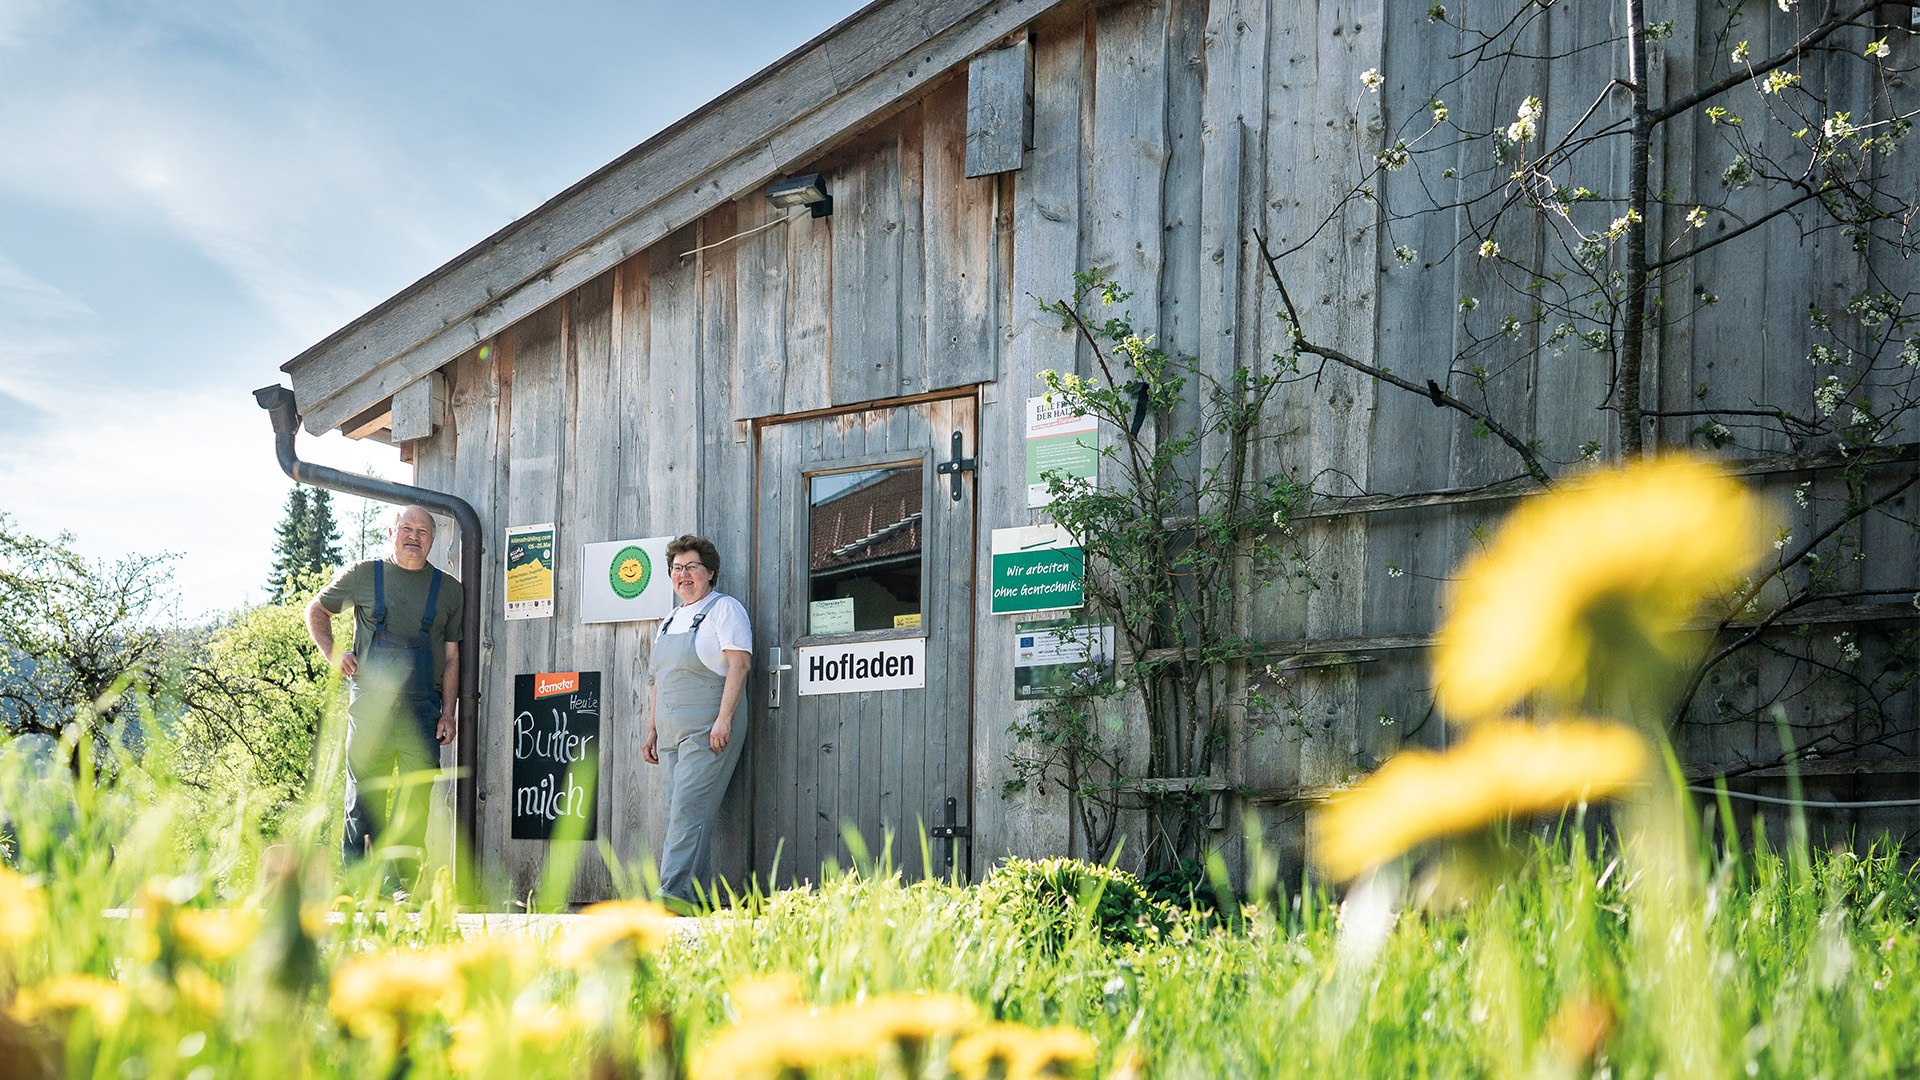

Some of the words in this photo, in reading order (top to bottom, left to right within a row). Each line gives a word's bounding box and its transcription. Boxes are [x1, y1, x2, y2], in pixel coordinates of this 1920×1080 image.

[1037, 411, 1053, 421] DER
[1006, 565, 1024, 576] Wir
[1026, 562, 1069, 576] arbeiten
[994, 586, 1018, 598] ohne
[809, 651, 914, 682] Hofladen
[538, 679, 574, 694] demeter
[570, 691, 598, 710] Heute
[514, 708, 594, 764] Butter
[517, 773, 586, 820] milch
